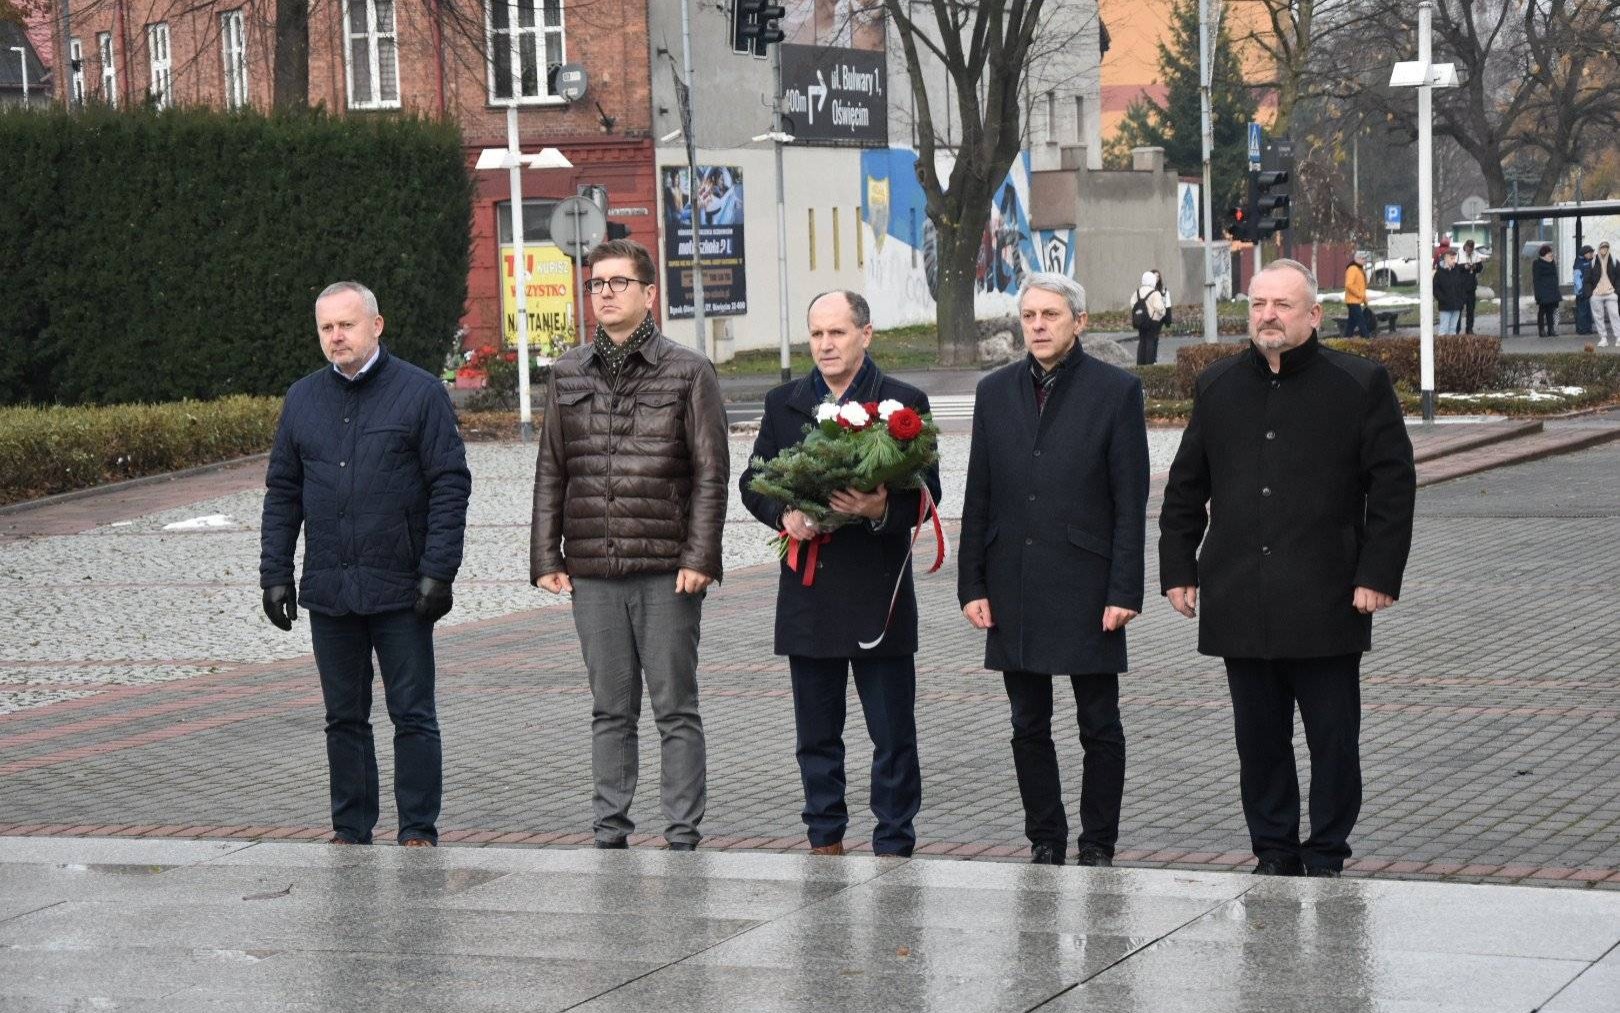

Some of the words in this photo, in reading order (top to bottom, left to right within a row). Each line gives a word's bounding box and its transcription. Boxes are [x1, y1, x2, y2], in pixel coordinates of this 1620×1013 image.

[831, 64, 841, 89] ul.
[842, 64, 873, 96] Bulwary
[832, 98, 869, 132] Oświęcim
[538, 260, 569, 275] KUPISZ
[510, 284, 567, 298] WZYSTKO
